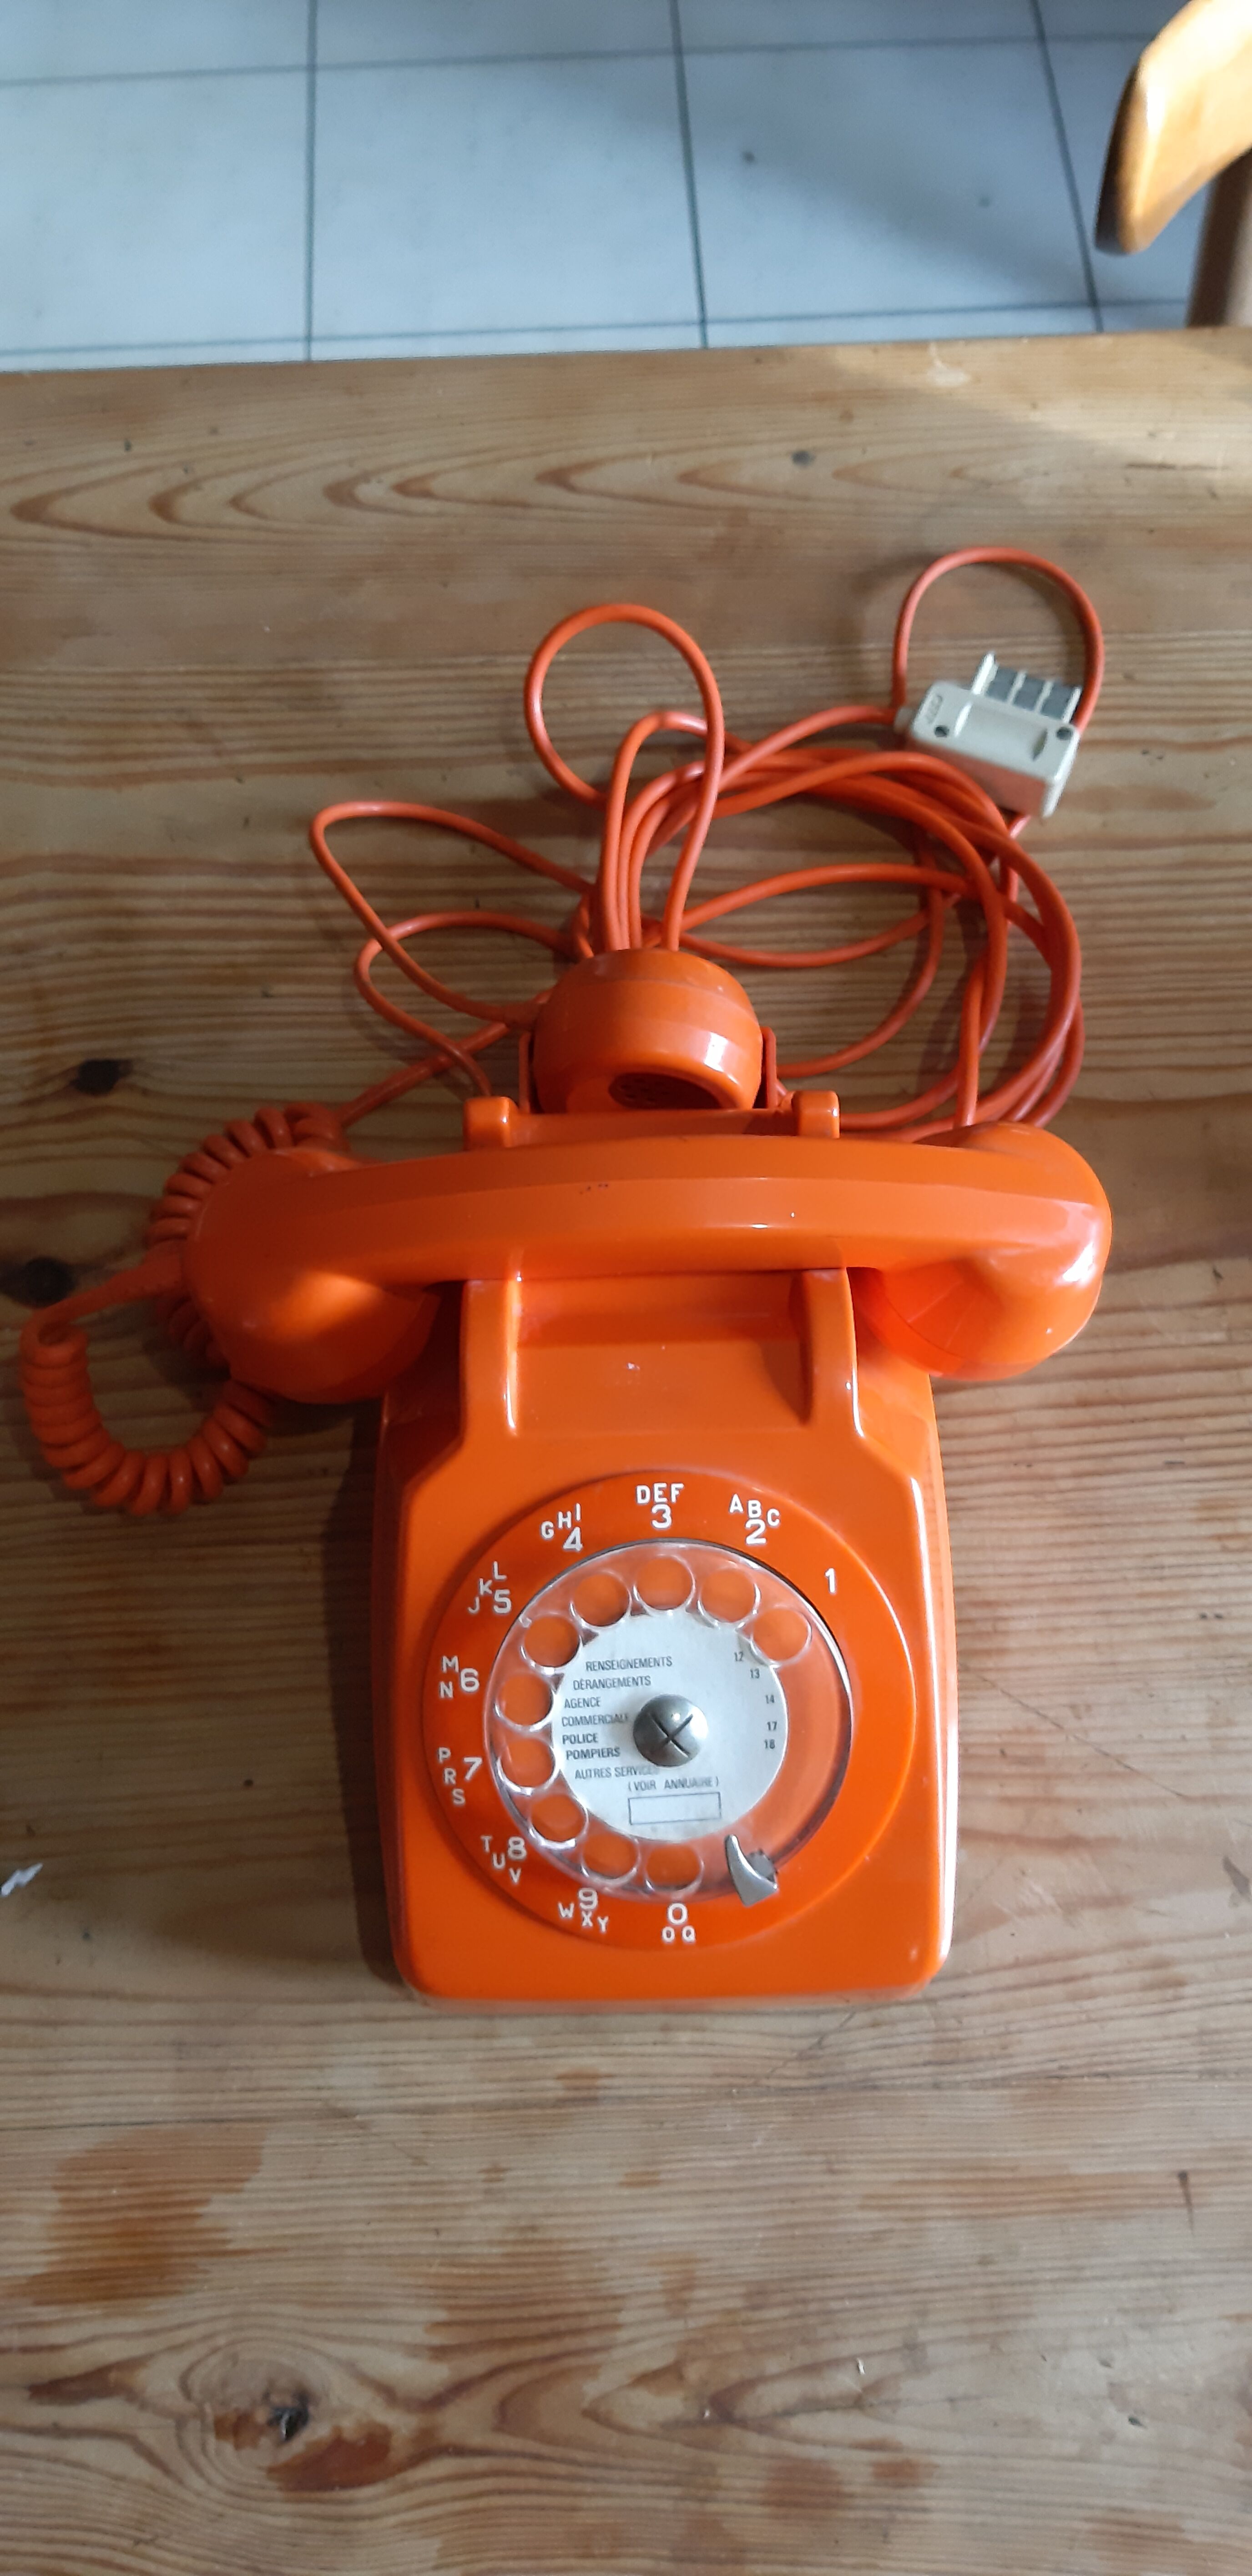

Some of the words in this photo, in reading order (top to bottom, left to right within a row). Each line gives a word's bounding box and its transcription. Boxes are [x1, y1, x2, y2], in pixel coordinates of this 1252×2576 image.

[636, 1483, 684, 1505] DEF
[651, 1505, 673, 1529] 3
[563, 1526, 583, 1552] 4
[745, 1519, 767, 1545] 2
[824, 1567, 838, 1595] 1
[493, 1589, 512, 1614] 5
[585, 1656, 672, 1671] RENSEIGNEMENTS
[734, 1651, 743, 1661] 12
[460, 1668, 480, 1693] 6
[573, 1675, 651, 1690] DÉRANGEMENTS
[750, 1668, 760, 1679] 13
[564, 1697, 601, 1708] AGENCE
[765, 1695, 775, 1704] 14
[562, 1734, 598, 1745] POLICE
[767, 1721, 777, 1731] 17
[565, 1747, 620, 1760] POMPIERS
[764, 1739, 776, 1749] 18
[464, 1757, 483, 1781] 7
[575, 1768, 612, 1780] AUTRES
[507, 1836, 527, 1860] 8
[578, 1888, 598, 1910] 9
